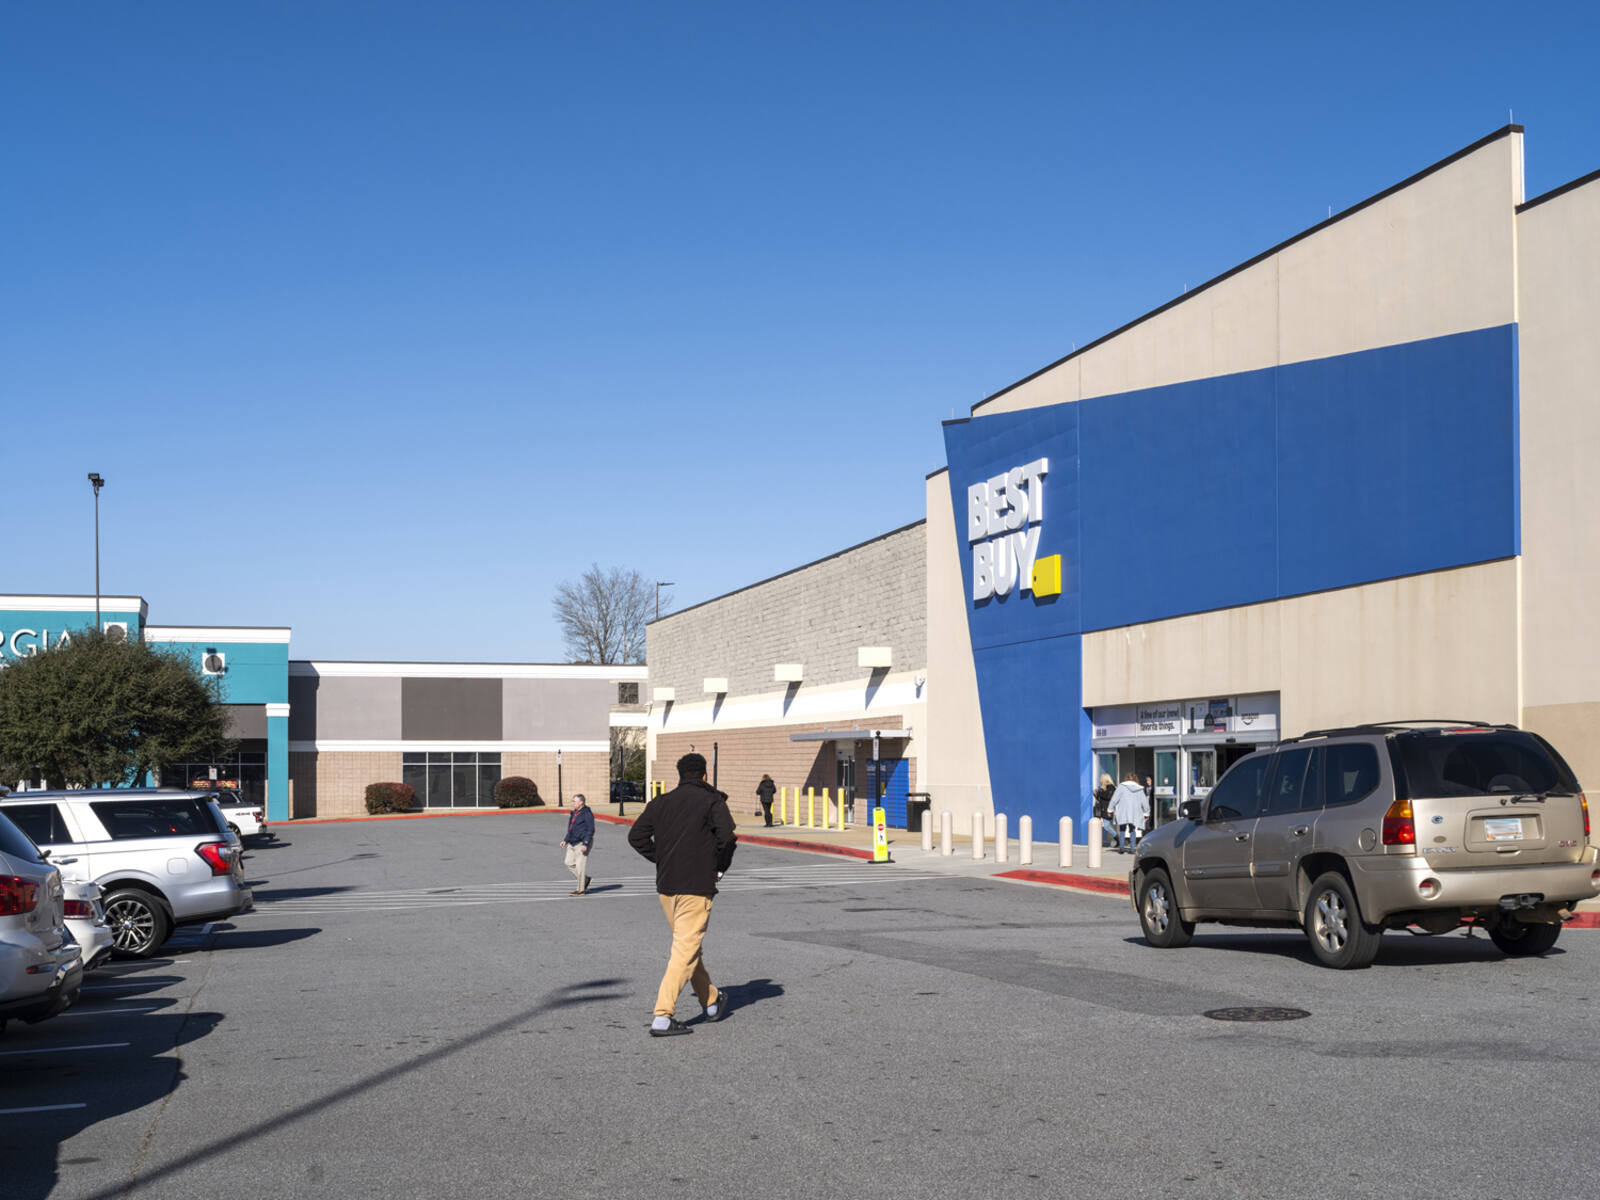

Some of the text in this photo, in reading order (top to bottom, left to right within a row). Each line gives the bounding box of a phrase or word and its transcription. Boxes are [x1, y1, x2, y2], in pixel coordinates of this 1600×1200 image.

[968, 458, 1048, 541] BEST
[974, 526, 1042, 600] BUY
[0, 628, 71, 657] GIA
[1140, 722, 1158, 732] favorite
